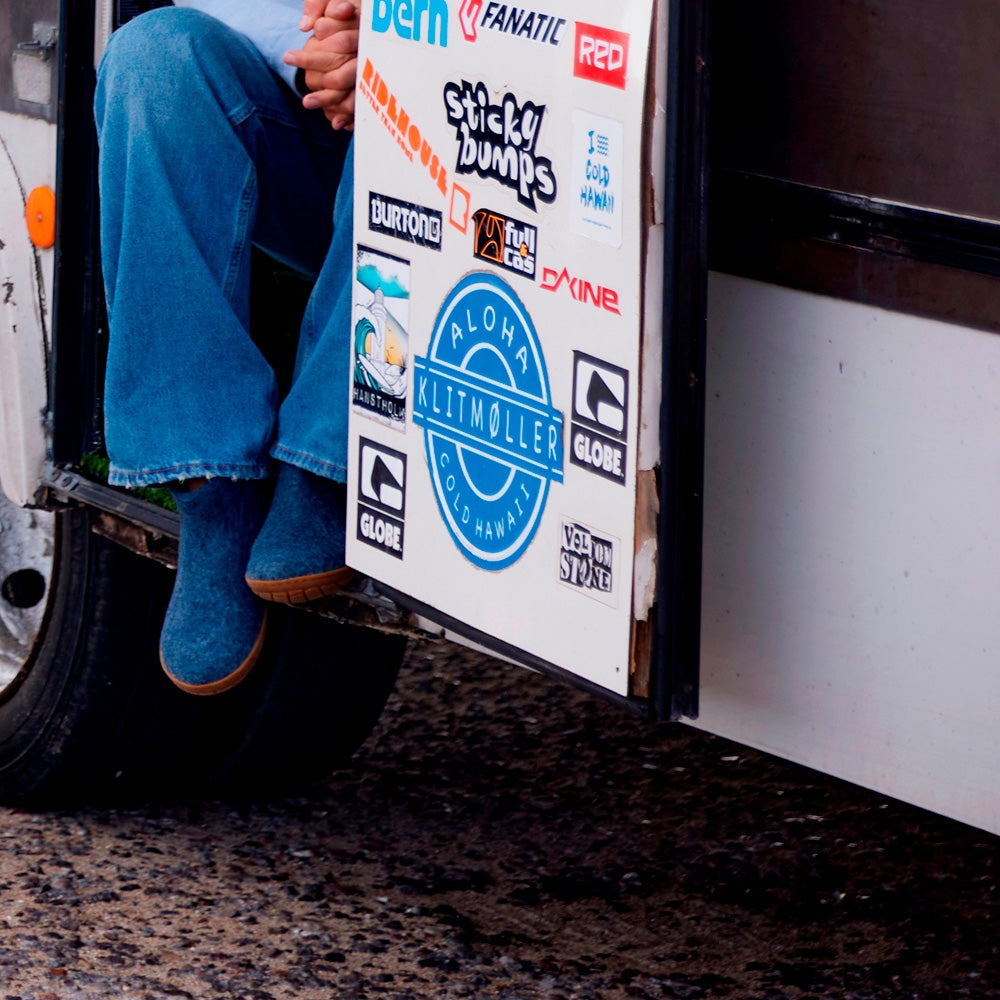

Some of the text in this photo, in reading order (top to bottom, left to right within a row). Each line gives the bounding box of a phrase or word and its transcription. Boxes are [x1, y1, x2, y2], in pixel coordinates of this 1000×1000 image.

[480, 1, 567, 46] FANATIC
[446, 90, 539, 151] sticky
[460, 121, 554, 199] bumps
[586, 159, 610, 188] COLD
[371, 198, 430, 240] BURTON
[580, 186, 614, 214] HAWAII
[504, 220, 535, 254] full
[504, 248, 535, 275] cas
[451, 305, 528, 374] ALOHA
[418, 375, 557, 462] KLITMØLLER
[573, 433, 623, 477] GLOBE
[440, 453, 530, 541] COLD HAWAII
[360, 512, 401, 551] GLOBE
[560, 552, 612, 593] STONE
